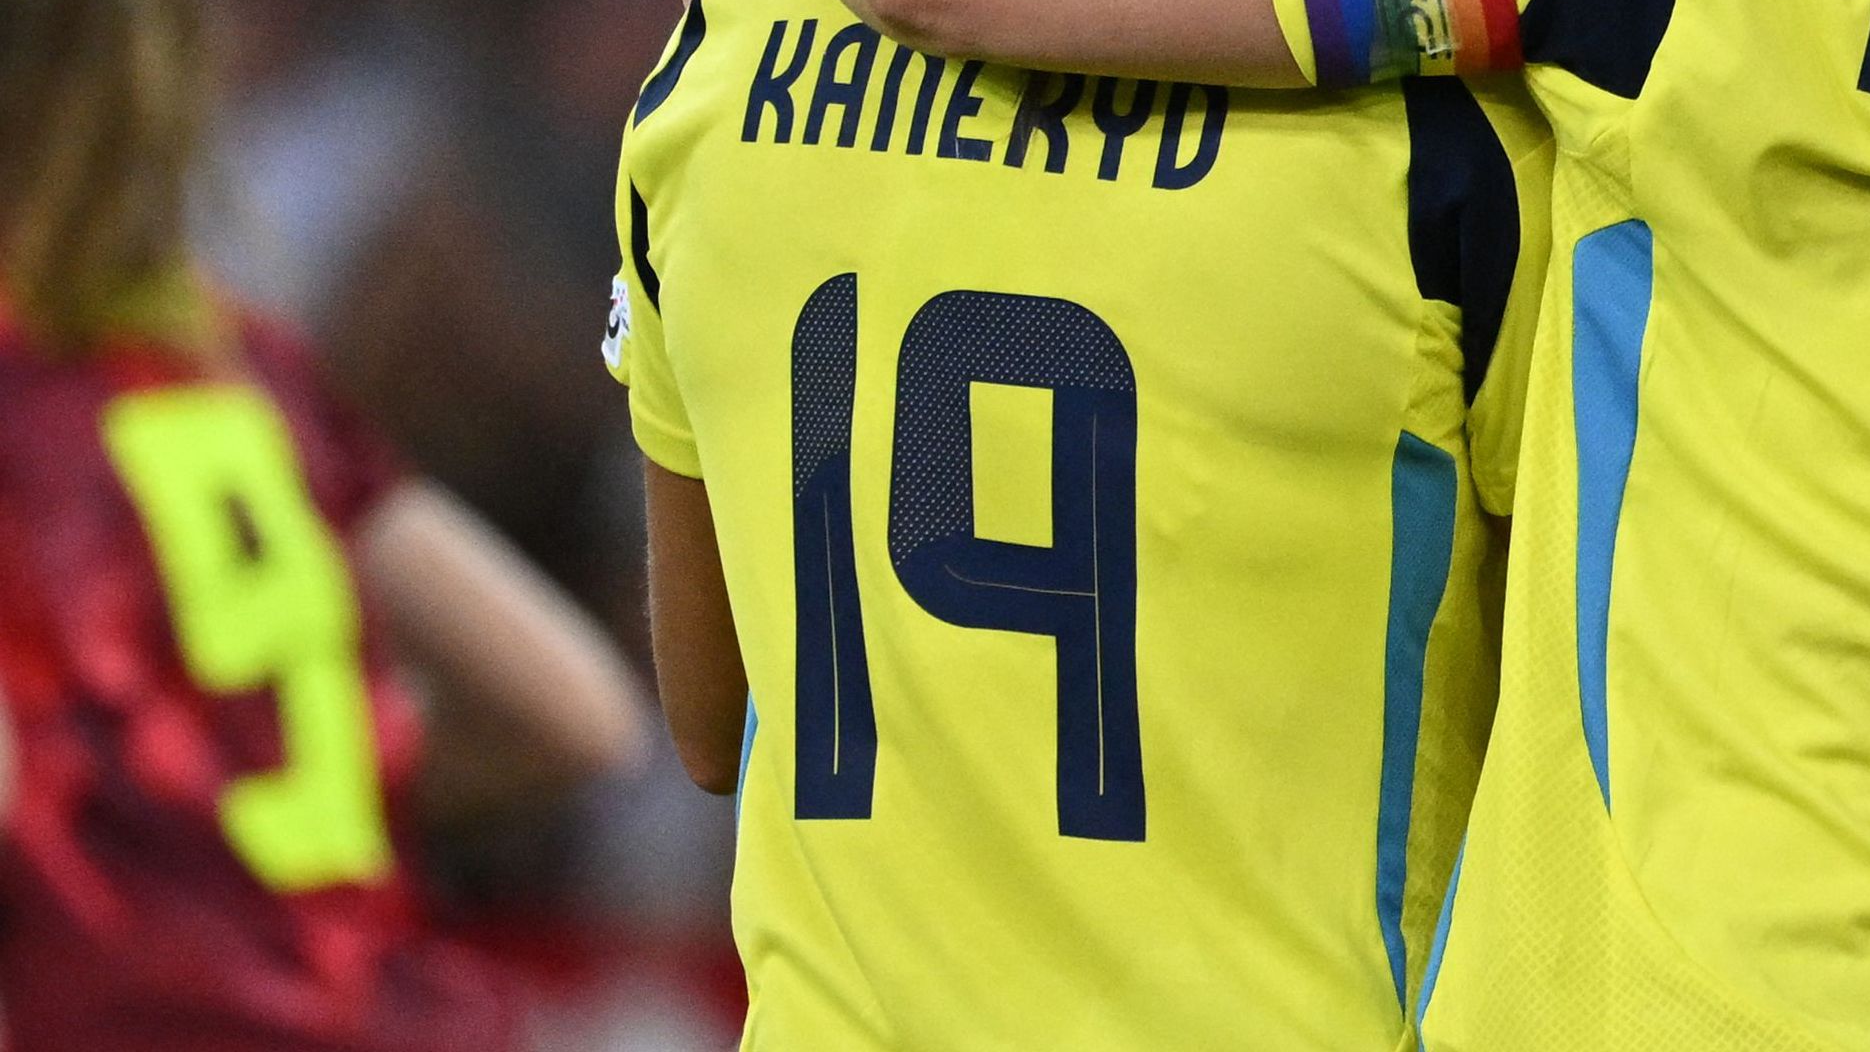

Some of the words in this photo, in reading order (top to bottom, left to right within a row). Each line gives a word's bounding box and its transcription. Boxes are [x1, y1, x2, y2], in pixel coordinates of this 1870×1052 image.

[742, 18, 1228, 190] KANERYD
[100, 384, 393, 892] 9
[791, 271, 1147, 842] 19
